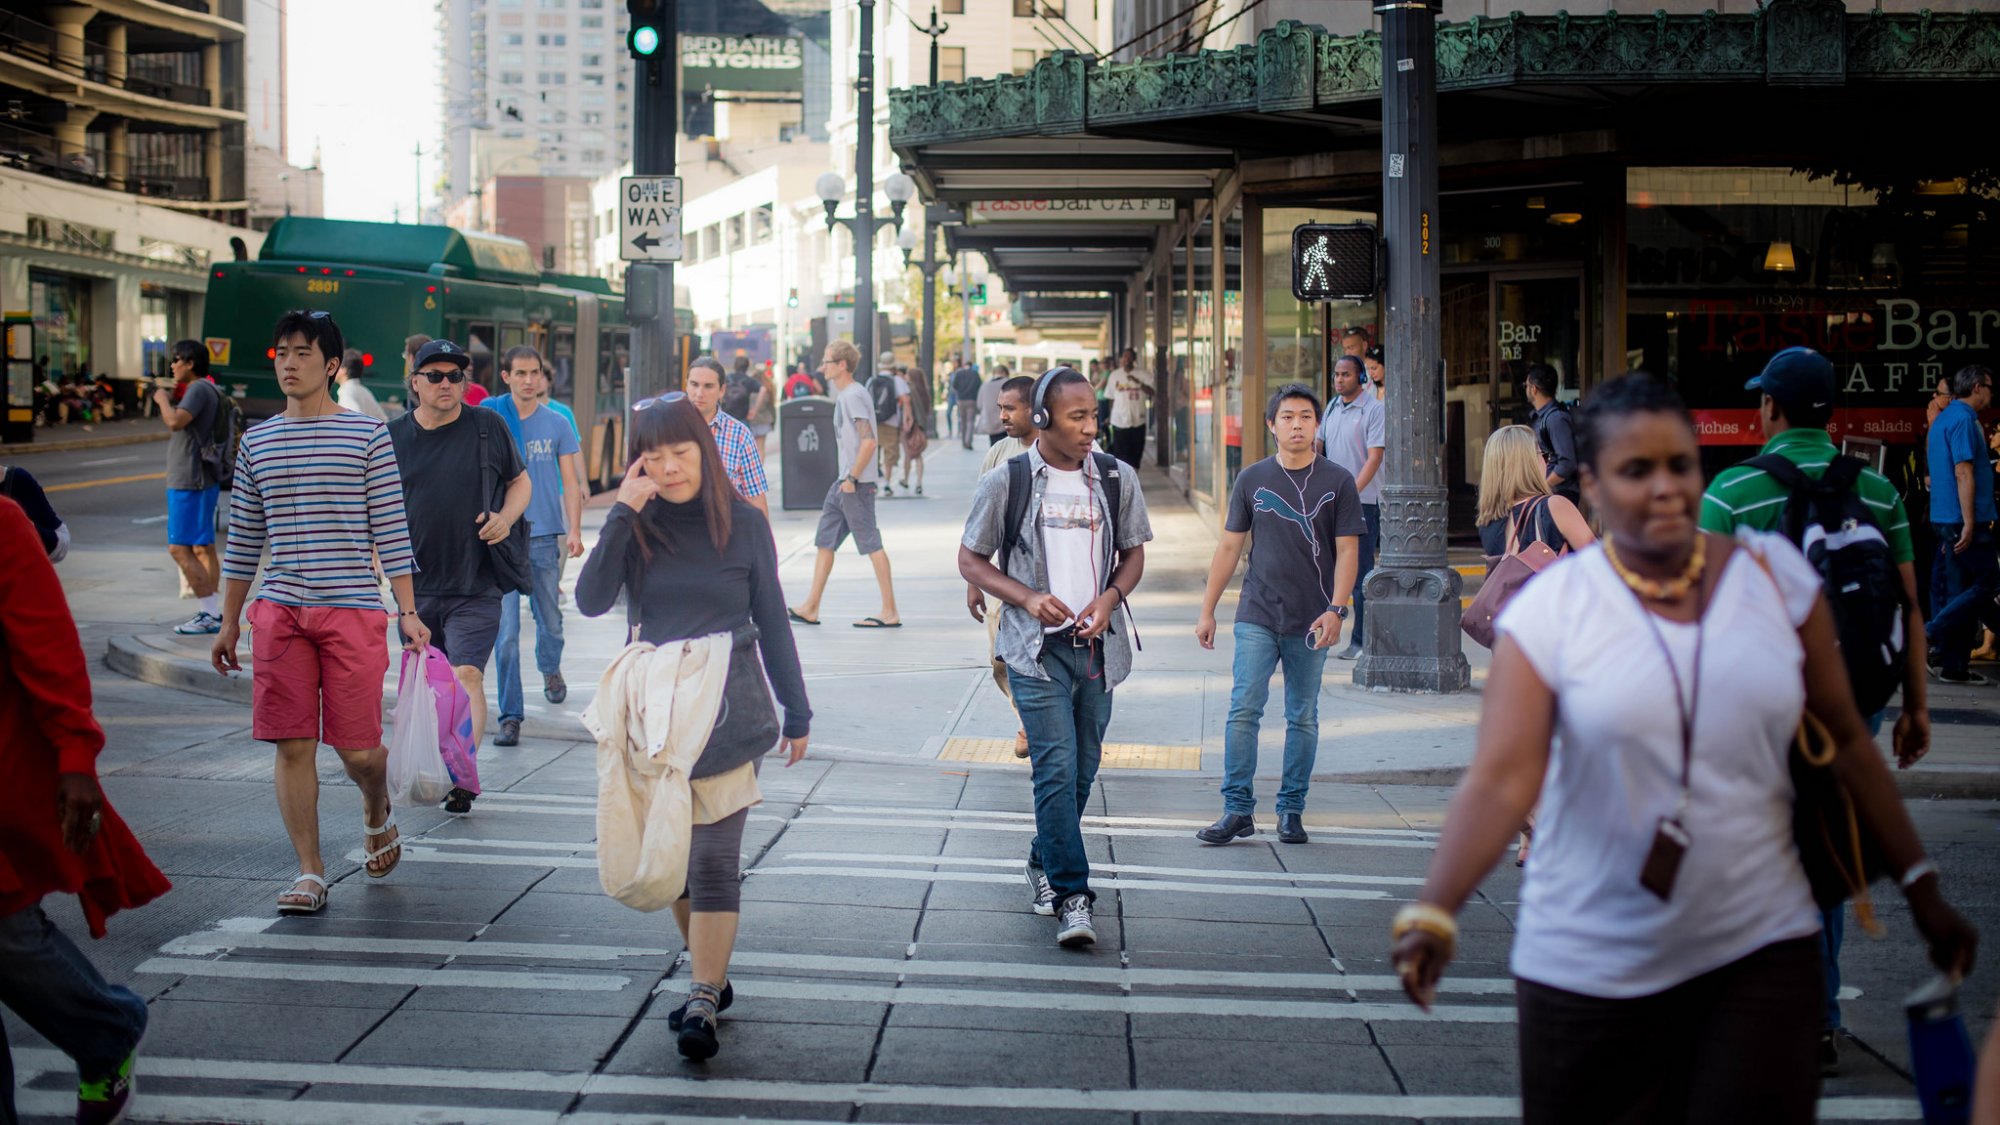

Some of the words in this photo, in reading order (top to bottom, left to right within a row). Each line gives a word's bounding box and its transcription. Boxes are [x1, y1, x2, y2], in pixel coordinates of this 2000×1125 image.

[682, 36, 722, 53] BED
[725, 37, 780, 55] BATH
[783, 38, 800, 55] &
[682, 53, 802, 69] BEYOND
[628, 207, 673, 226] WAY
[306, 279, 339, 294] 2801
[1499, 321, 1542, 342] Bar
[1842, 354, 1944, 393] AFÉ
[1863, 419, 1913, 433] salads
